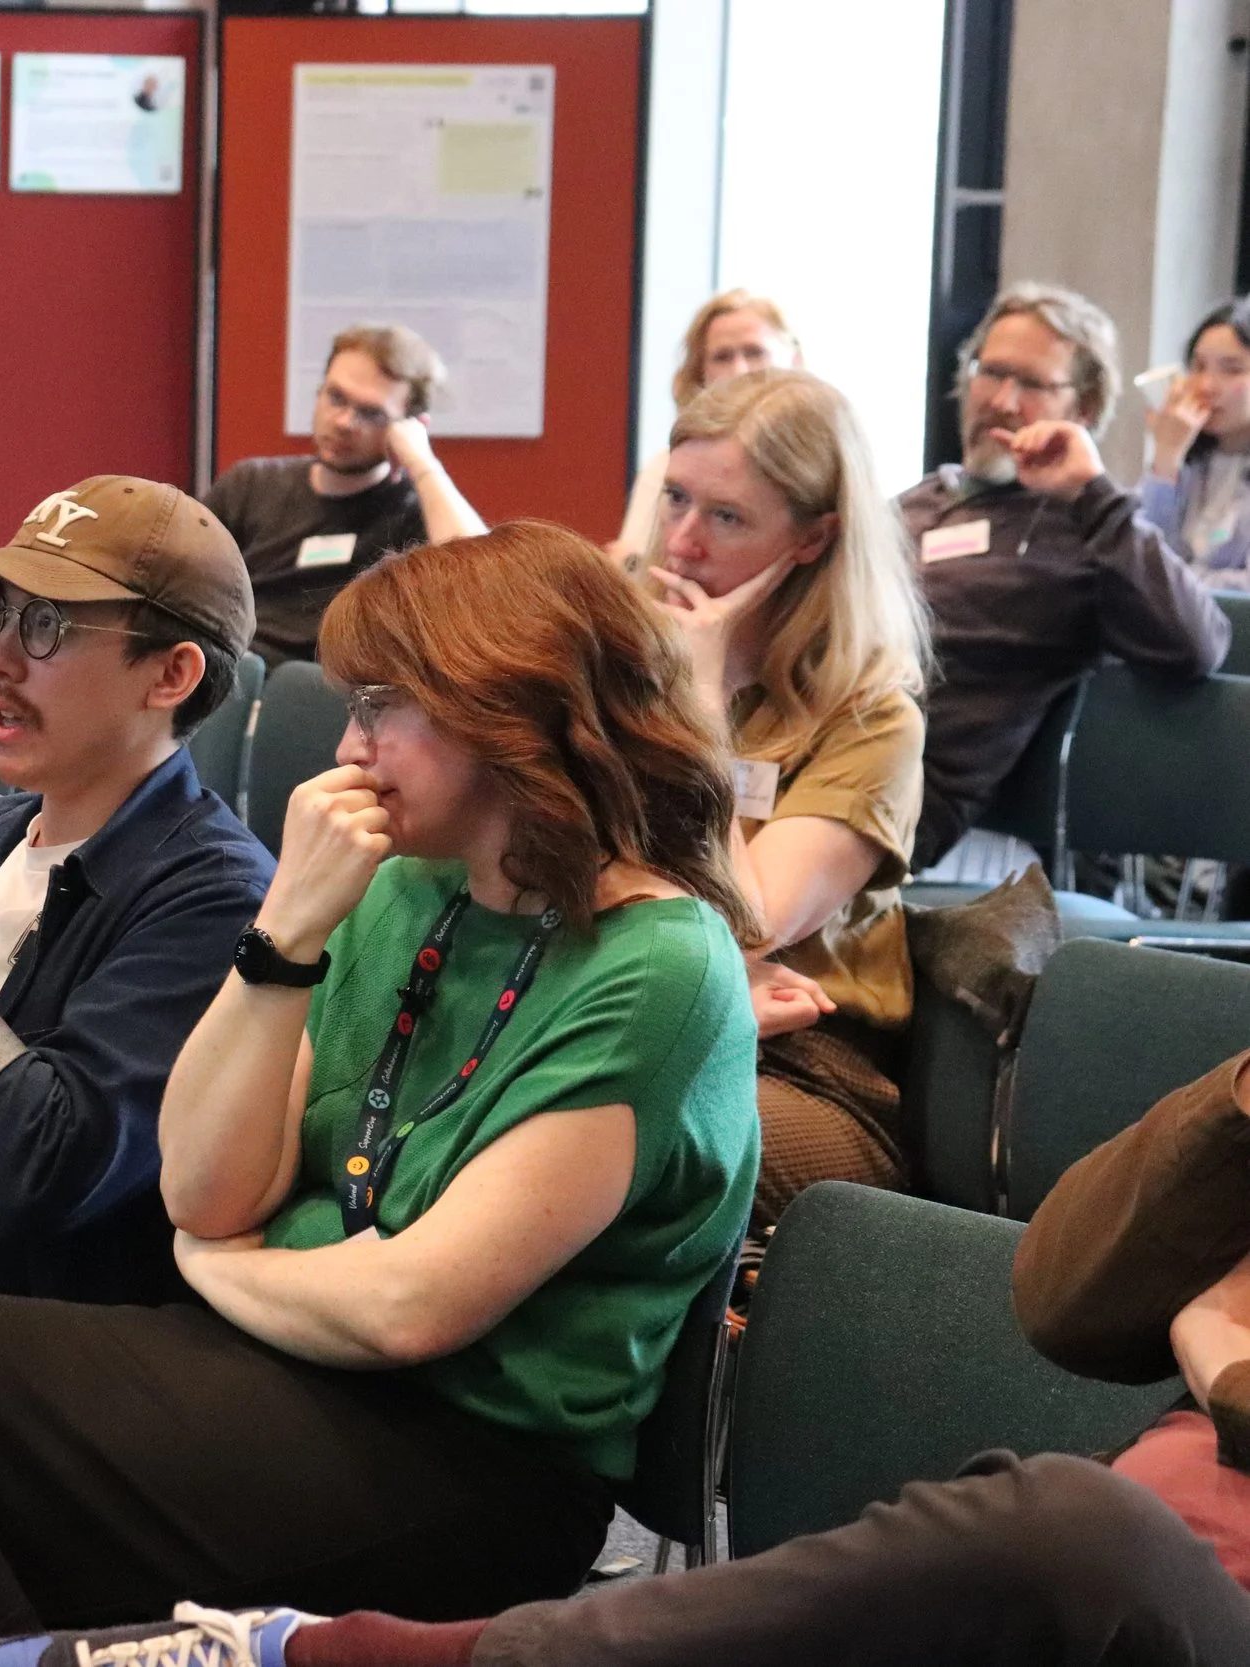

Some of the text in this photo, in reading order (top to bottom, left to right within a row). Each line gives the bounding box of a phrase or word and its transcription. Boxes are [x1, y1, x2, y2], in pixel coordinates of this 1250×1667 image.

[23, 491, 99, 548] NY
[358, 1115, 377, 1150] Supportive
[348, 1183, 359, 1210] Valued
